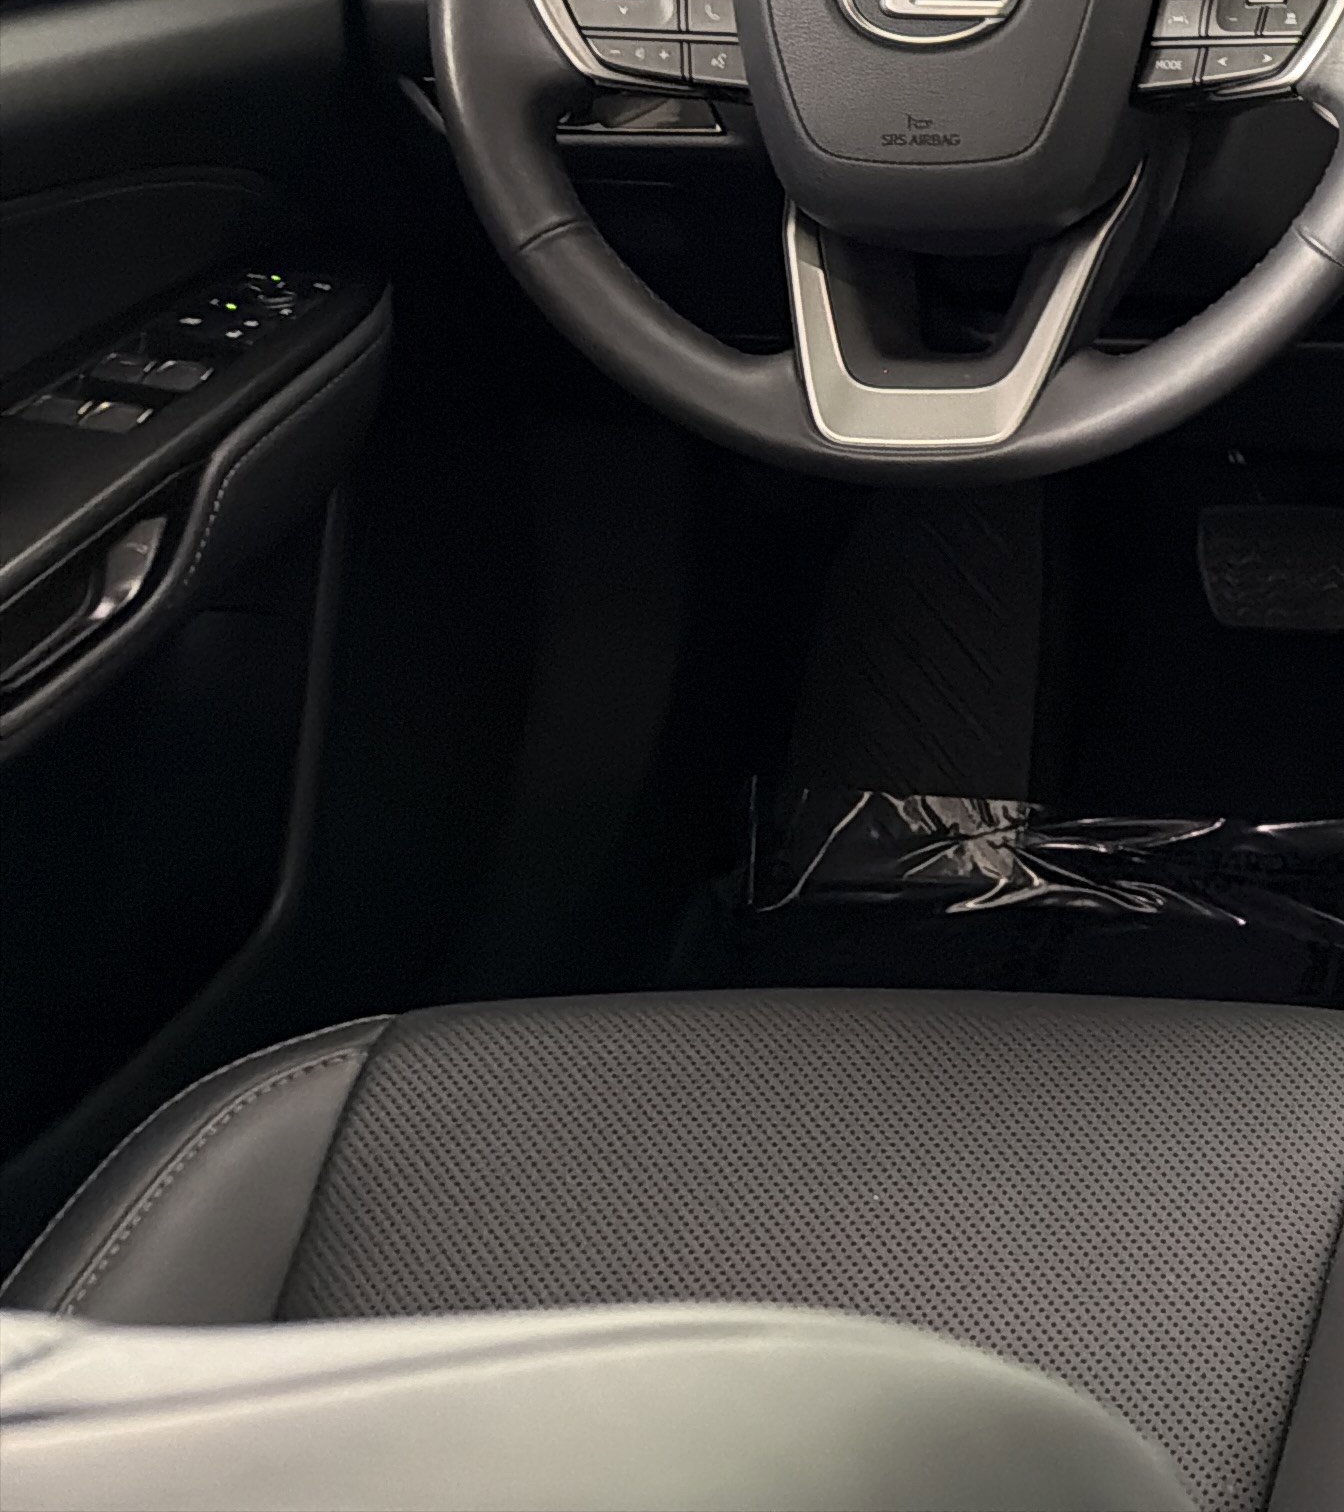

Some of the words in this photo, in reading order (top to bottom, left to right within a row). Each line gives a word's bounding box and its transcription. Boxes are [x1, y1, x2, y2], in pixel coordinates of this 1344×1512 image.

[1155, 59, 1183, 71] MODE
[881, 133, 907, 147] SRS
[908, 133, 961, 146] AIRBAG
